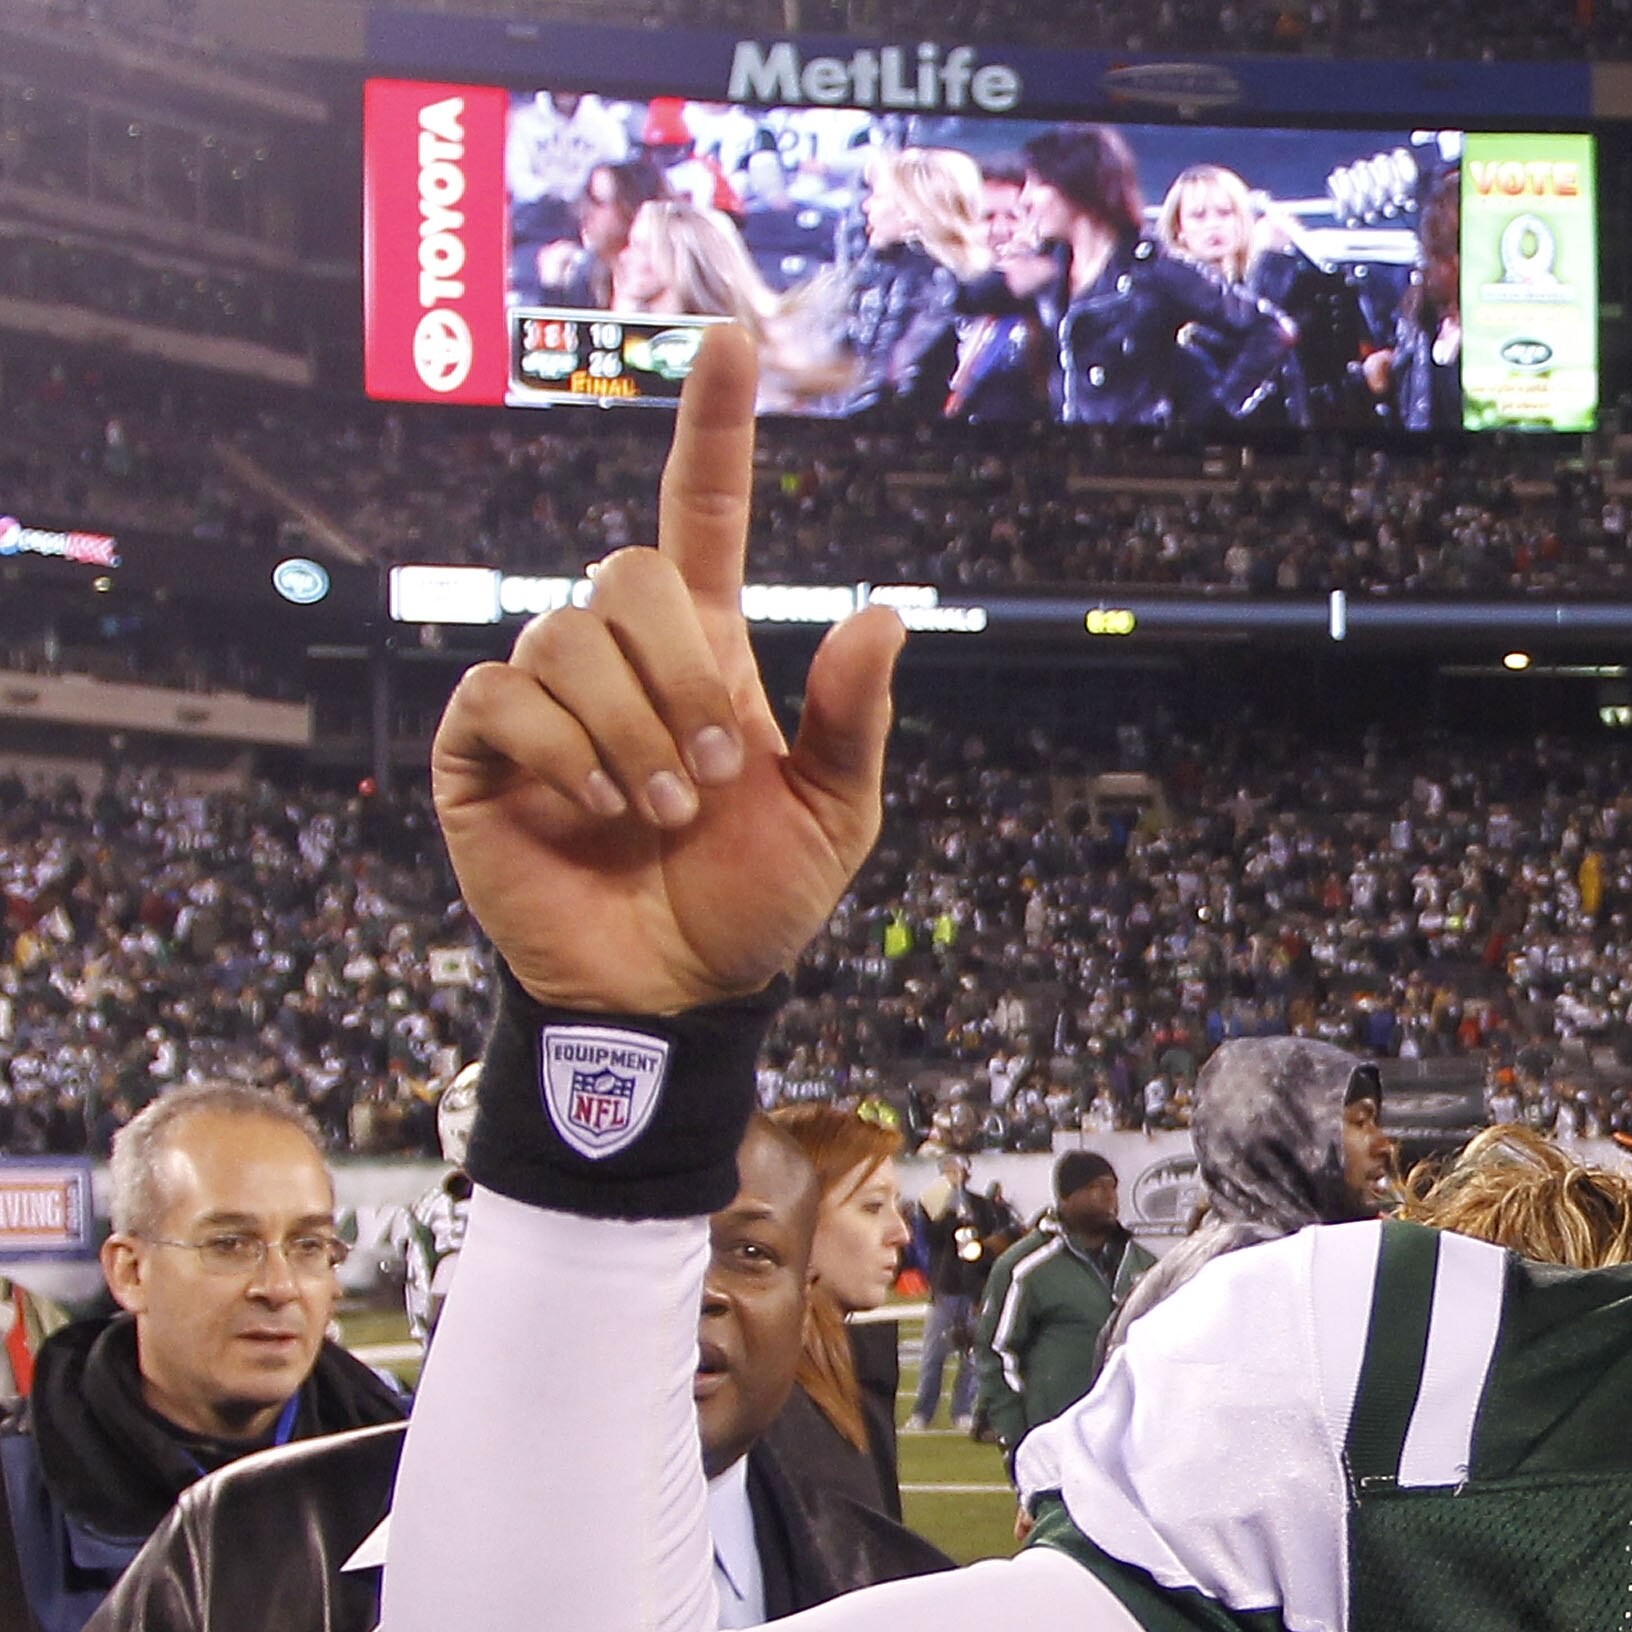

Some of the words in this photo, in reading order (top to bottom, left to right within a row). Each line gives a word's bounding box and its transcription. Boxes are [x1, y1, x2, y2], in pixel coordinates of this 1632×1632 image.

[727, 40, 1022, 113] MetLife
[1469, 161, 1579, 196] VOTE
[417, 97, 467, 301] TOYOTA
[590, 322, 623, 350] 10
[570, 370, 638, 396] FINAL
[554, 1044, 658, 1073] EQUIPMENT
[574, 1094, 627, 1130] NFL
